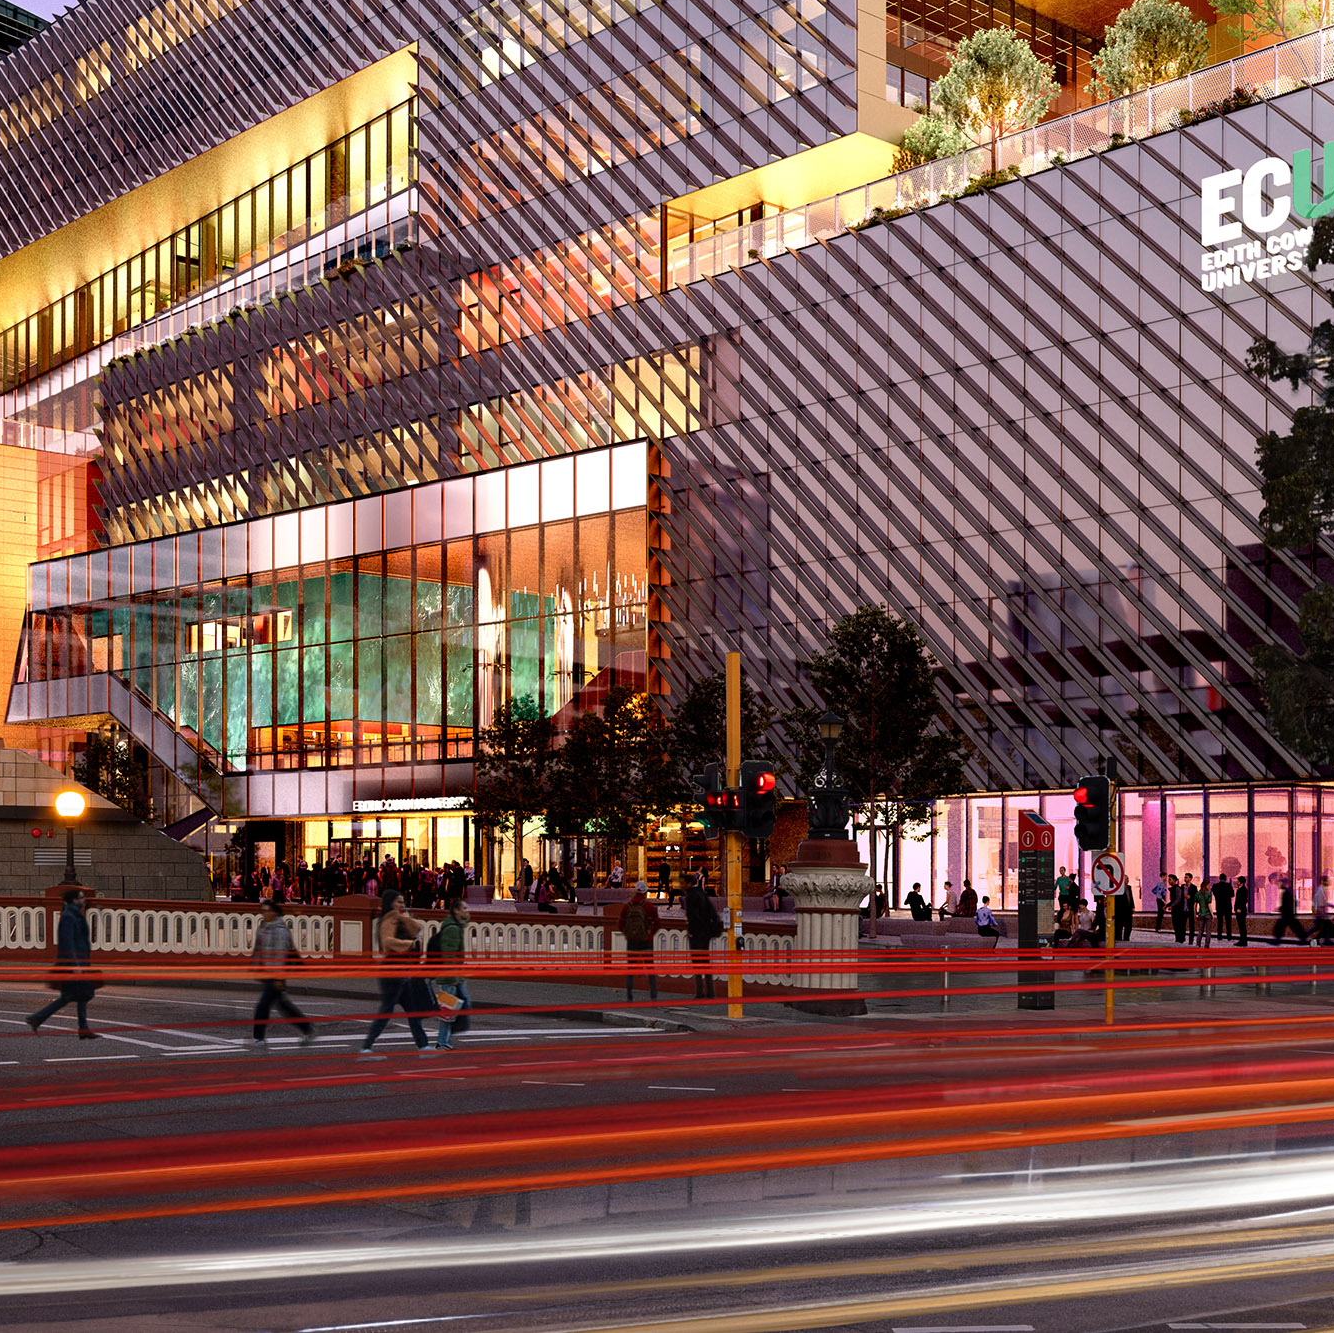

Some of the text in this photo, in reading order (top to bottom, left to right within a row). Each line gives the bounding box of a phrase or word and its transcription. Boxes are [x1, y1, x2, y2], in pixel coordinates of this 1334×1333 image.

[1201, 226, 1314, 272] EDITH COW
[1201, 247, 1311, 293] UNIVERS
